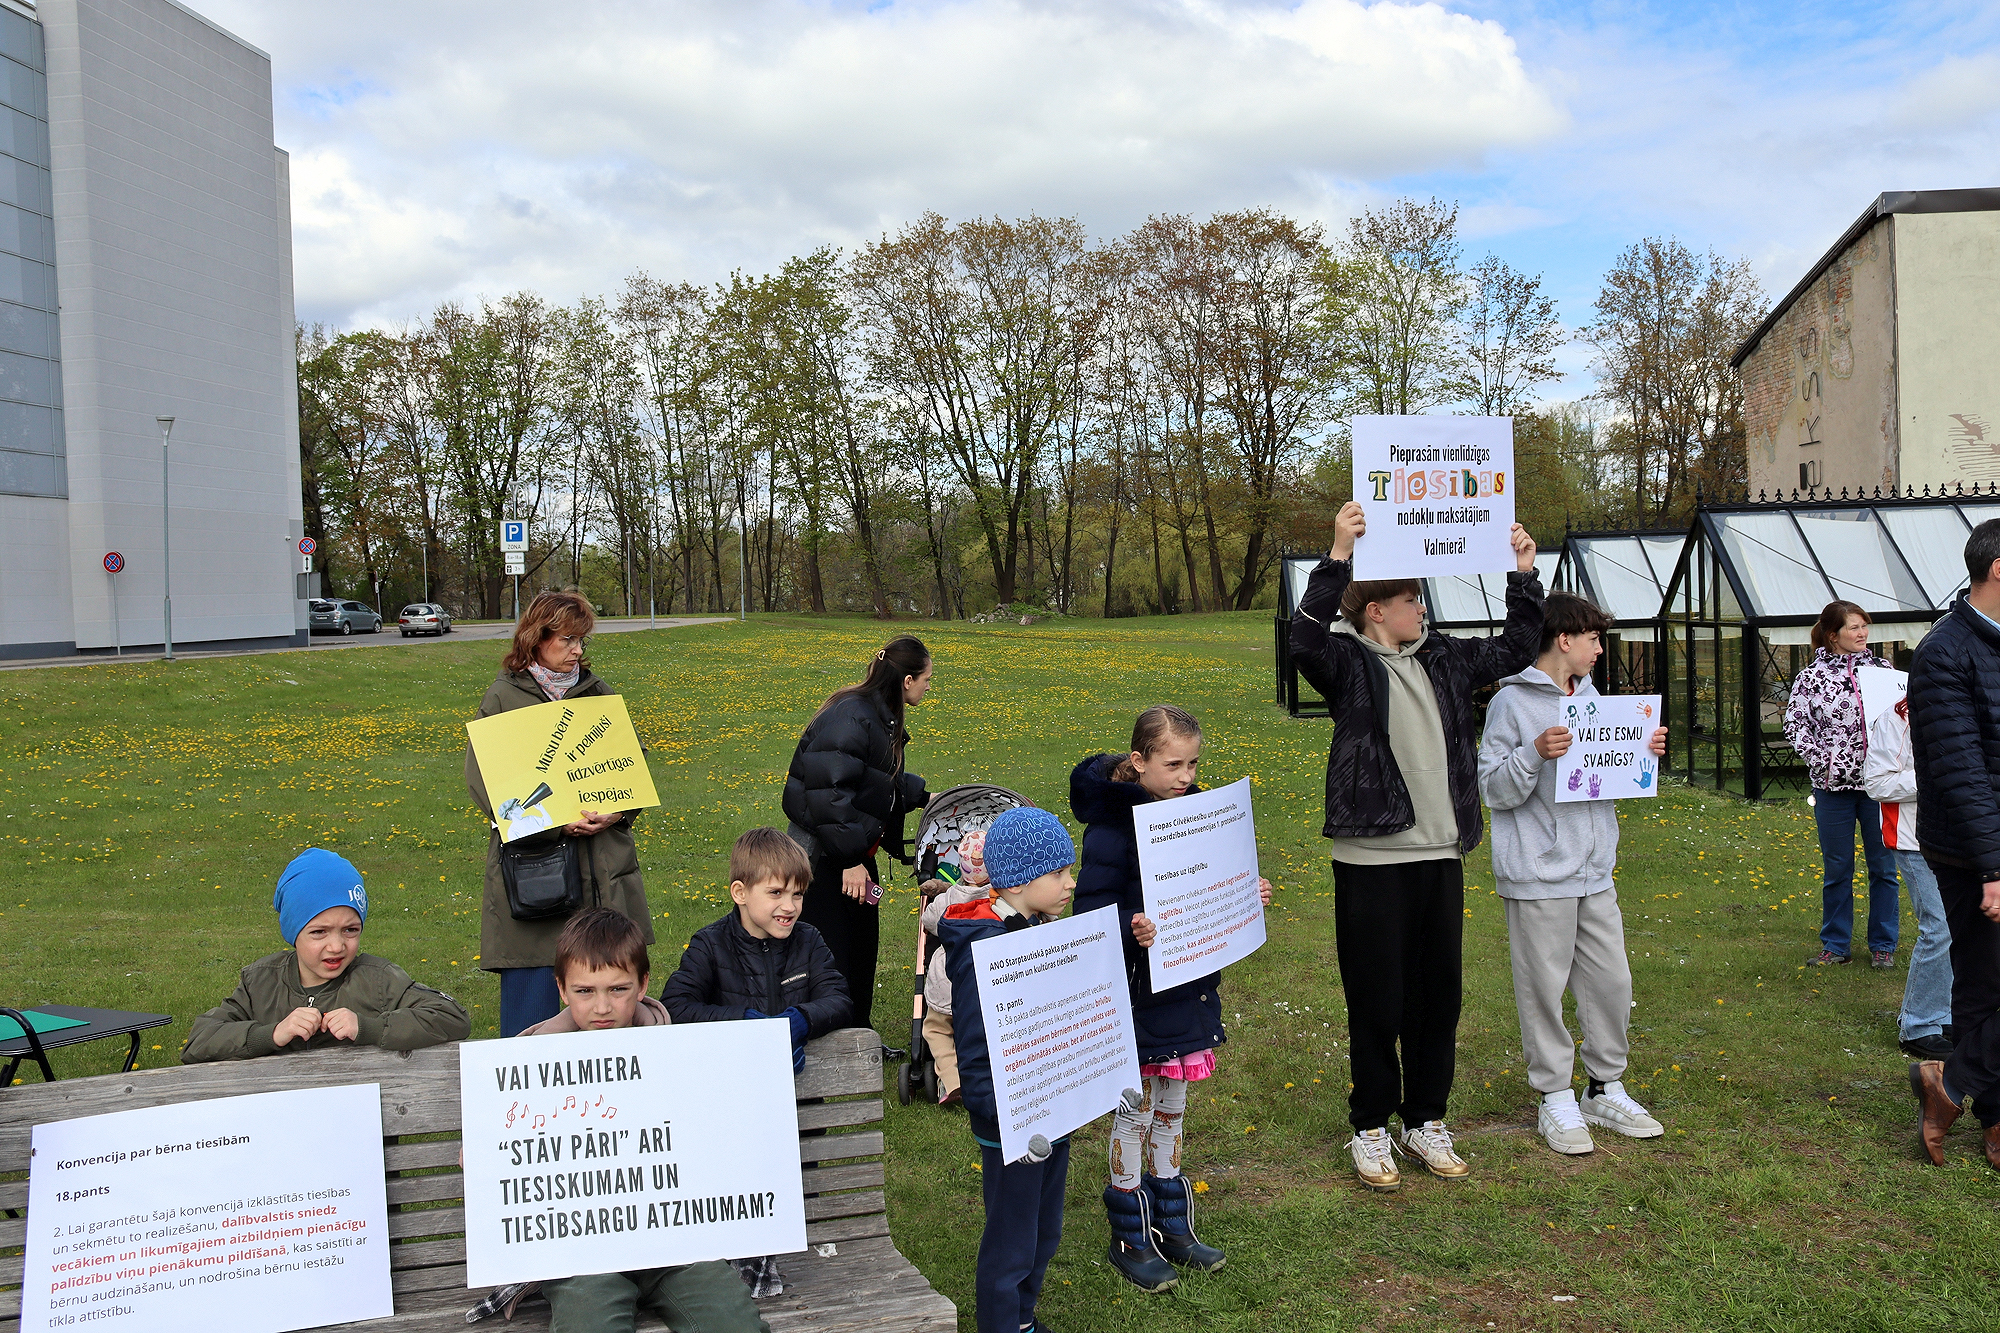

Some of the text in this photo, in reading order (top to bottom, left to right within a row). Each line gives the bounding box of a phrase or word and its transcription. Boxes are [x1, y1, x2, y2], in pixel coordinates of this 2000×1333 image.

[1390, 445, 1490, 466] Pieprasām vienlīdzīgas
[1398, 506, 1489, 528] nodokļu maksātājiem
[1424, 537, 1465, 555] Valmierā!
[536, 707, 574, 773] Mūsu bērni
[565, 715, 612, 762] ir pelnījuši
[1579, 727, 1642, 742] VAI ES ESMU
[567, 757, 634, 782] līdzvērtīgas
[1584, 750, 1634, 768] SVARĪGS?
[578, 788, 633, 803] iespējas!
[1149, 821, 1173, 832] Eiropas
[1172, 812, 1207, 827] Cilvēktiesību
[1150, 830, 1187, 845] aizsardzības
[1187, 822, 1217, 836] konvencijas
[1154, 870, 1180, 882] Tiesības
[1187, 862, 1208, 875] izglītību
[1157, 894, 1186, 907] Nevienam
[1186, 887, 1207, 900] cilvēkam
[1158, 907, 1183, 921] izglītību.
[1184, 902, 1200, 912] Veicot
[1159, 919, 1184, 933] attiecībā
[1191, 911, 1210, 924] izglītību
[1160, 923, 1210, 945] tiesības nodrošināt
[989, 959, 1005, 972] ANO
[1005, 948, 1045, 967] Starptautiskā
[1044, 945, 1061, 958] pakta
[1060, 942, 1070, 954] par
[1161, 944, 1187, 957] mācības,
[1186, 941, 1197, 949] kas
[1163, 951, 1204, 969] filozofiskajiem
[991, 954, 1078, 987] sociālajām un kultūras tiesībām
[995, 998, 1024, 1013] 13. pants
[997, 1018, 1004, 1028] 3.
[1004, 1014, 1013, 1026] Šā
[1013, 1011, 1029, 1025] pakta
[1028, 1000, 1057, 1018] dalībvalstis
[1057, 993, 1079, 1008] apņemas
[1000, 1027, 1028, 1043] attiecīgos
[1027, 1017, 1054, 1036] gadījumos
[1053, 1010, 1075, 1023] likumīgo
[1074, 1002, 1095, 1016] aizbildņu
[1002, 1041, 1030, 1057] izvēlēties
[1030, 1034, 1051, 1047] saviem
[1050, 1025, 1073, 1039] bērniem
[1072, 1022, 1080, 1030] ne
[1004, 1058, 1027, 1073] orgānu
[1052, 1041, 1070, 1054] skolas,
[1070, 1036, 1080, 1046] bet
[495, 1055, 642, 1092] VAI VALMIERA
[1006, 1074, 1025, 1088] atbilst
[1024, 1070, 1036, 1080] tam
[1035, 1060, 1057, 1077] izglītības
[1056, 1053, 1076, 1069] prasību
[1008, 1087, 1028, 1102] noteikt
[1028, 1082, 1036, 1094] vai
[1036, 1072, 1063, 1091] apstiprināt
[1010, 1104, 1027, 1117] bērnu
[1027, 1094, 1049, 1109] reliģisko
[1048, 1090, 1056, 1100] un
[1055, 1080, 1079, 1097] tikumisko
[1012, 1120, 1025, 1132] savu
[57, 1135, 250, 1171] Konvencija par bērna tiesībām
[498, 1120, 671, 1166] “STĀV PĀRI” ARĪ
[56, 1186, 110, 1202] 18.pants
[499, 1163, 679, 1206] TIESISKUMAM UN
[53, 1188, 351, 1238] 2. Lai garantētu šajā konvencijā izklāstītās tiesības
[501, 1191, 775, 1244] TIESĪBSARGU ATZINUMAM?
[52, 1204, 337, 1256] un sekmētu to realizēšanu, dalībvalstis sniedz
[52, 1219, 366, 1273] vecākiem un likumīgajiem aizbildņiem pienācīgu
[51, 1236, 368, 1293] palīdzību viņu pienākumu pildīšanā, kas saistīti ar
[50, 1254, 344, 1310] bērnu audzināšanu, un nodrošina bērnu iestāžu
[49, 1305, 135, 1328] tīkla attīstību.
